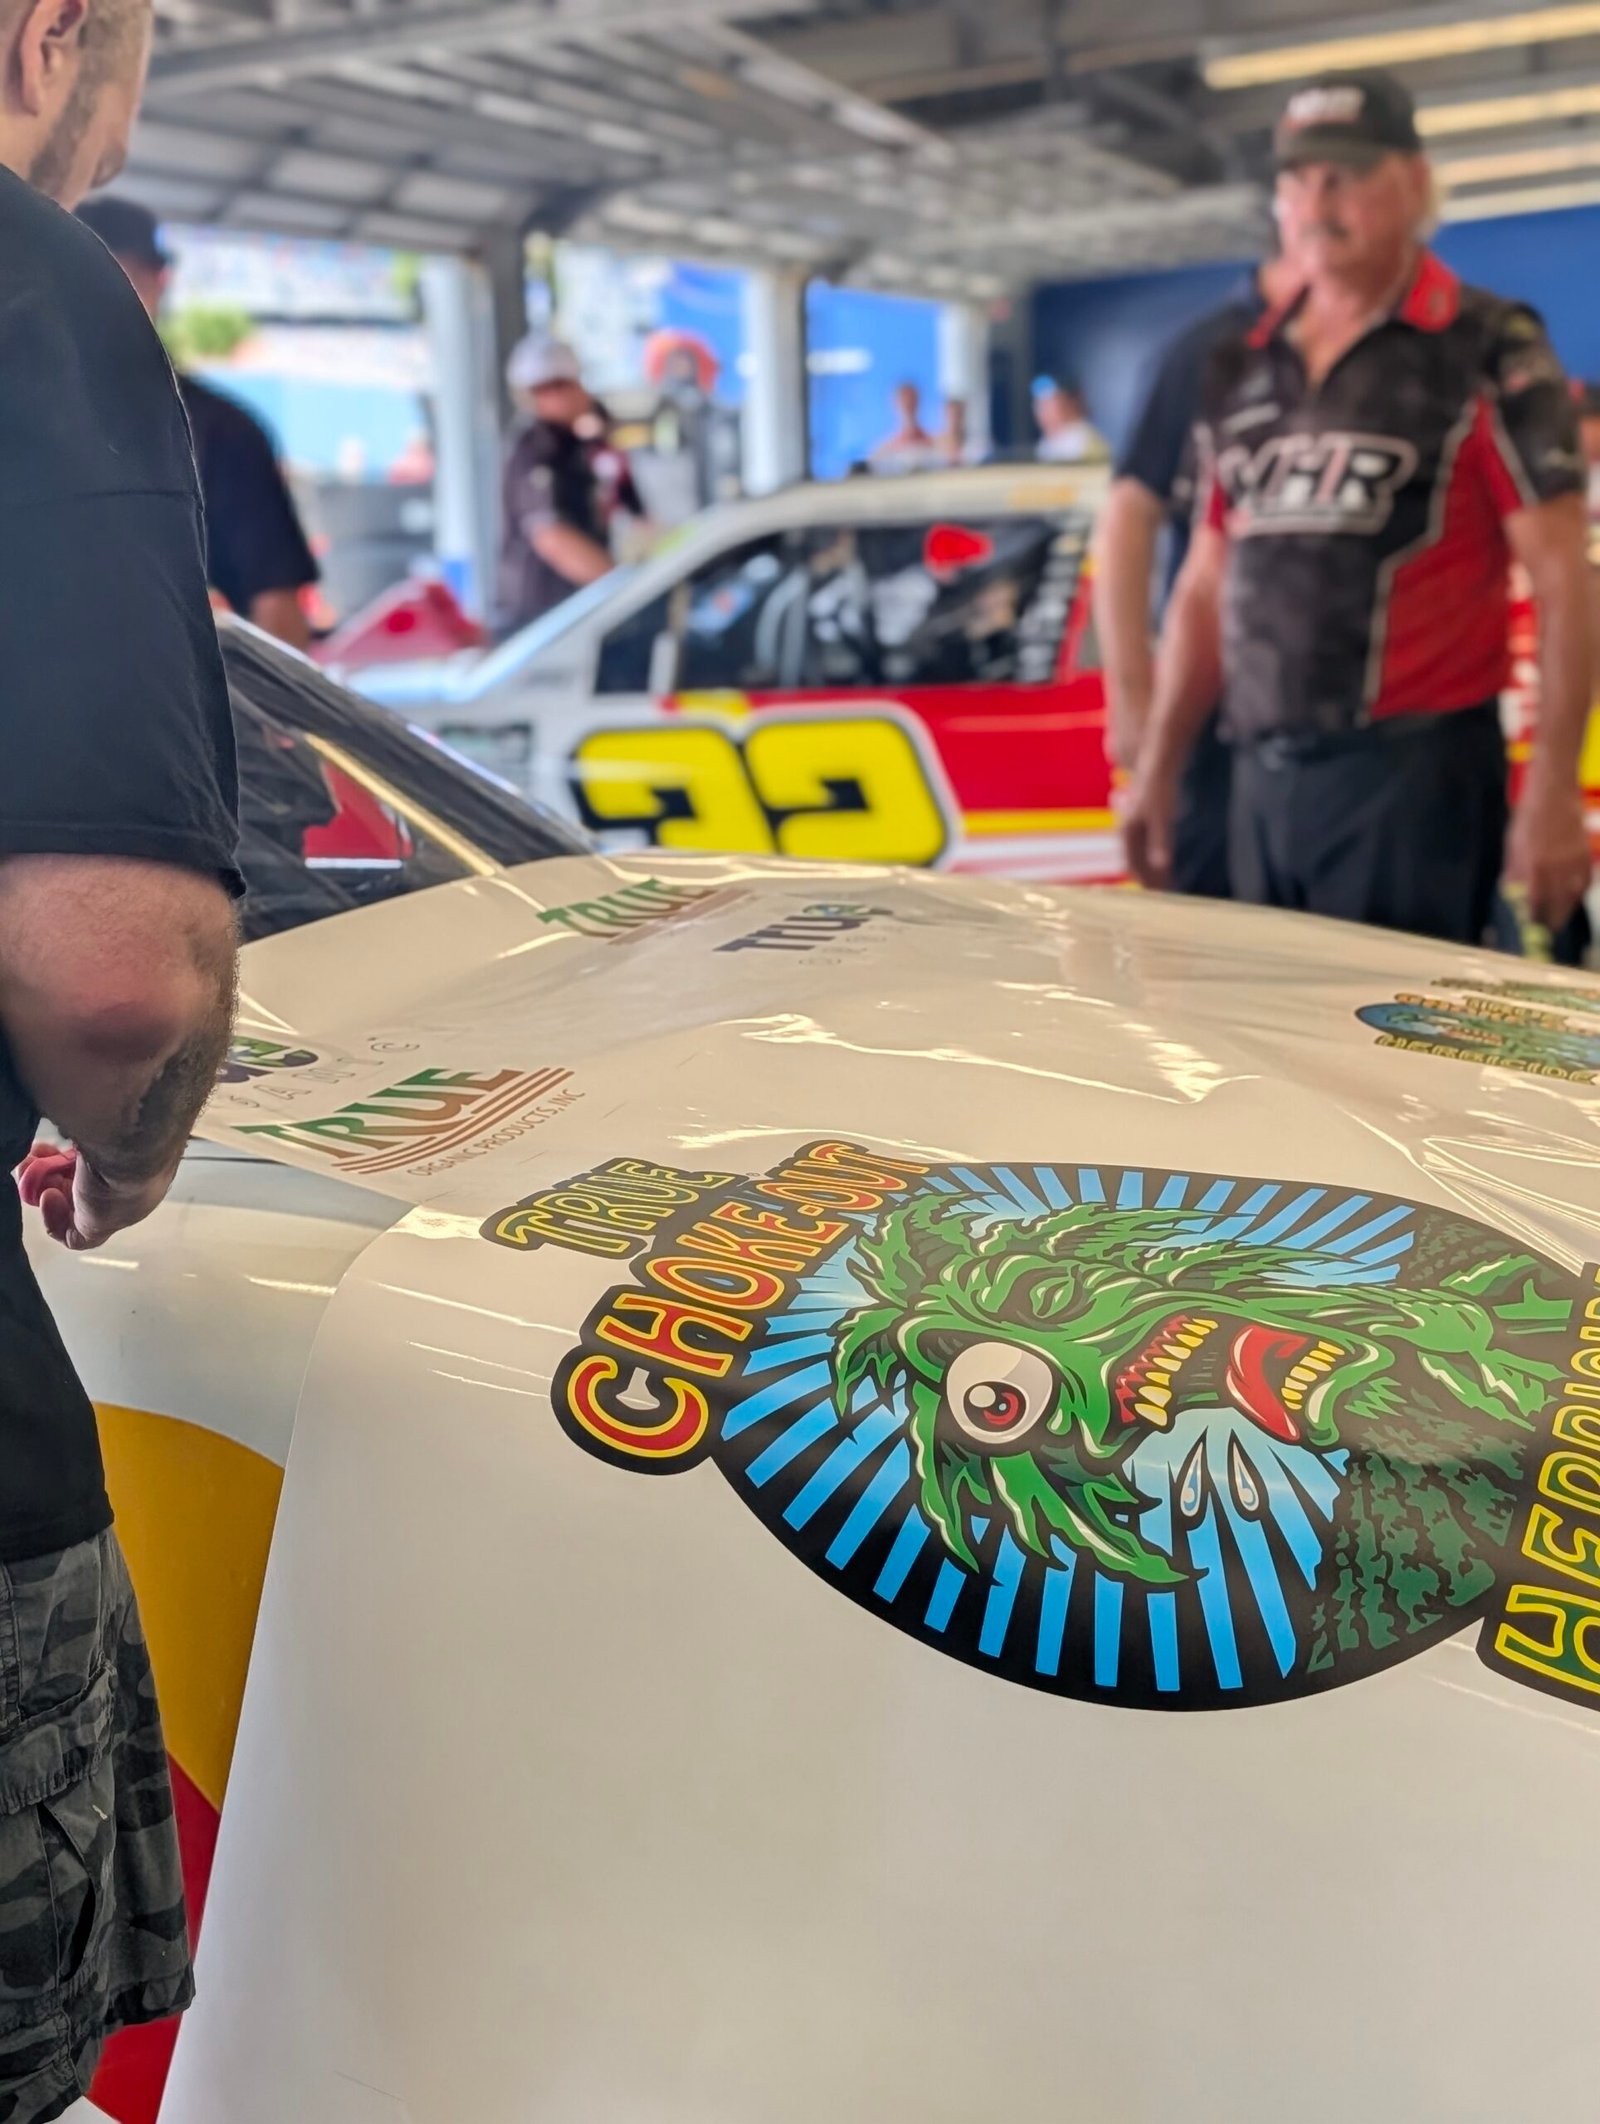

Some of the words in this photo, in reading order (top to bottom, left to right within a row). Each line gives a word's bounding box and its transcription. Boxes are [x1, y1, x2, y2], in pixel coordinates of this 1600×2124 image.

[536, 877, 720, 938] TRUE
[229, 1067, 525, 1158] TRUE
[407, 1147, 488, 1177] ORGANIC
[496, 1160, 735, 1254] TRUE
[567, 1142, 930, 1458] CHOKE-OUT
